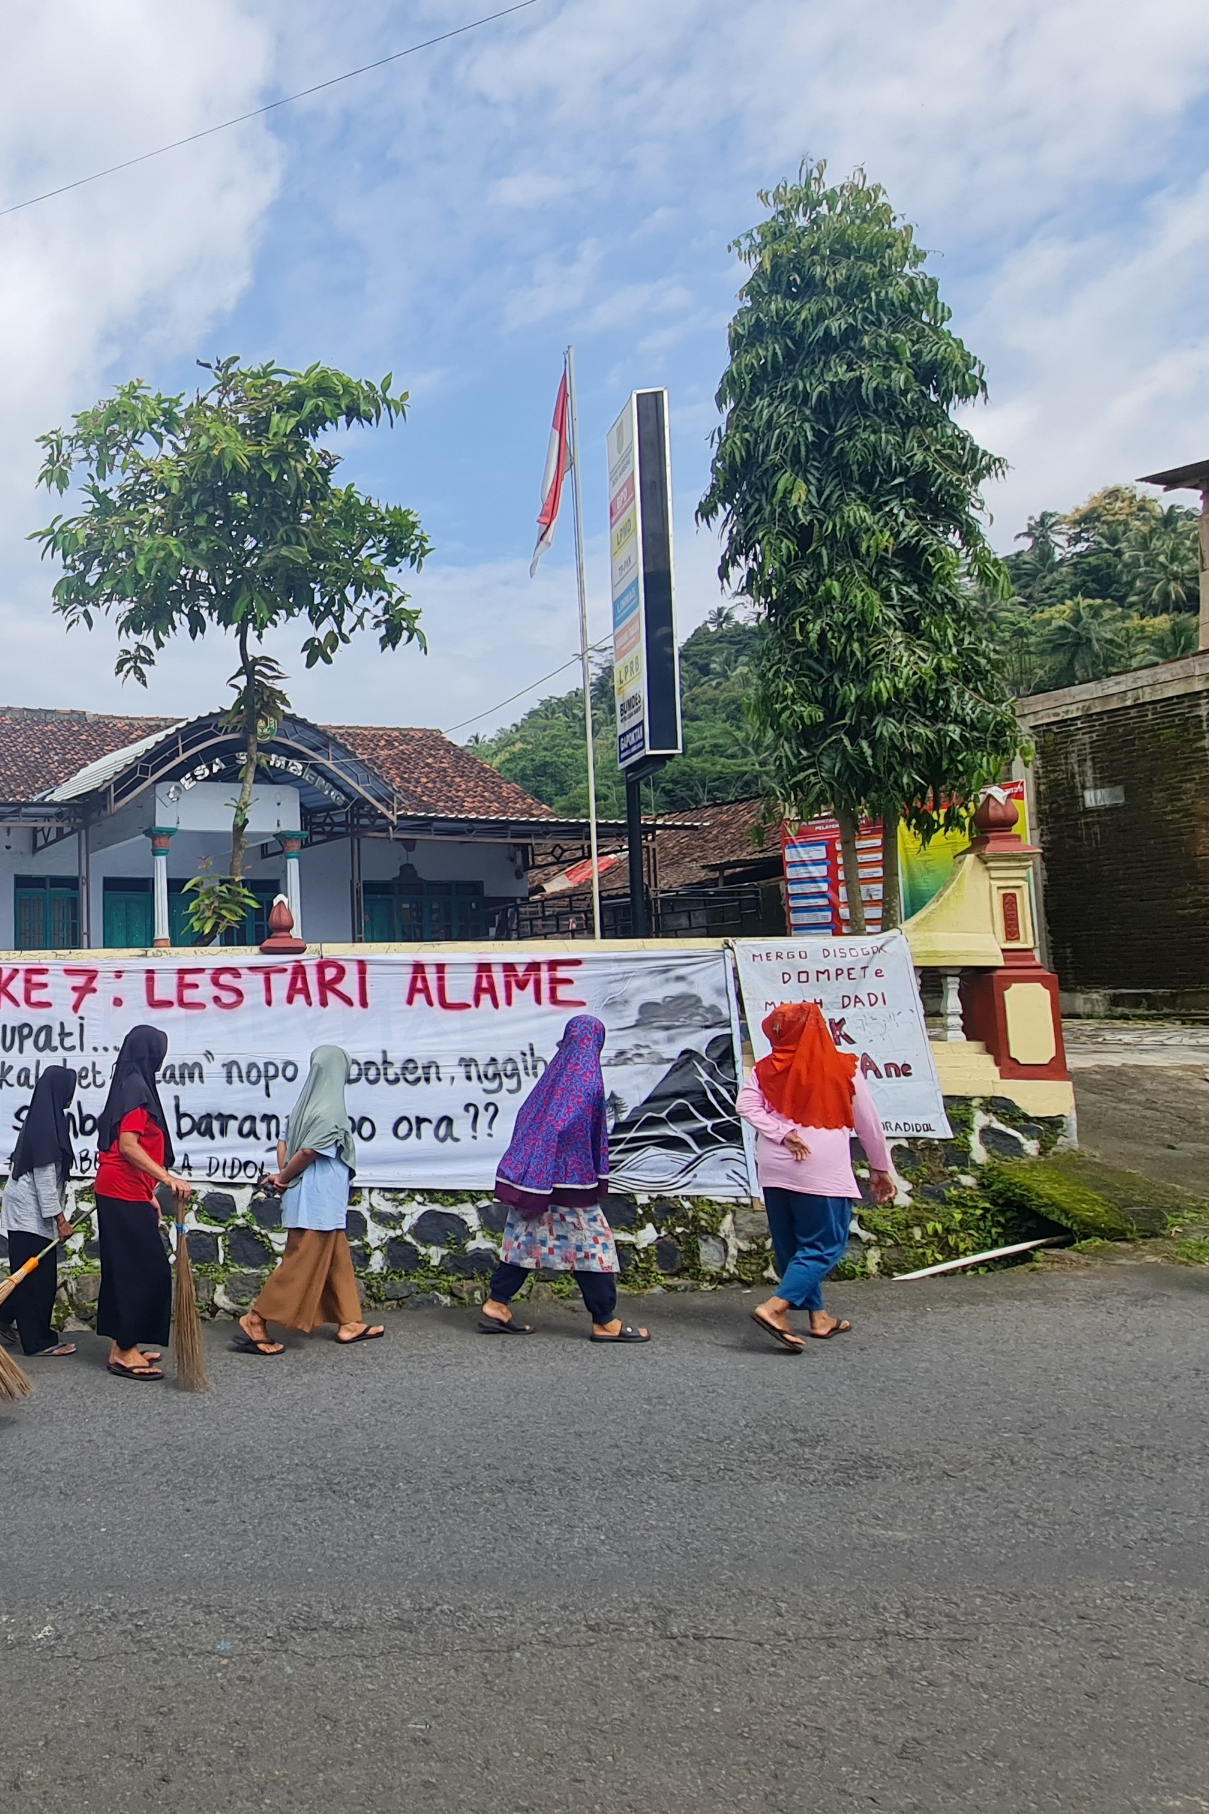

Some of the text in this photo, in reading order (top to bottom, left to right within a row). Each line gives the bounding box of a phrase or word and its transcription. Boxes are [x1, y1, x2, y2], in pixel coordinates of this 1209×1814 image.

[235, 751, 347, 806] SMBENG
[752, 945, 888, 963] MERGO DISOGOK
[144, 960, 368, 1010] LESTARI
[406, 959, 588, 1010] ALAME
[841, 991, 887, 1010] DADI
[221, 1060, 299, 1098] nopo
